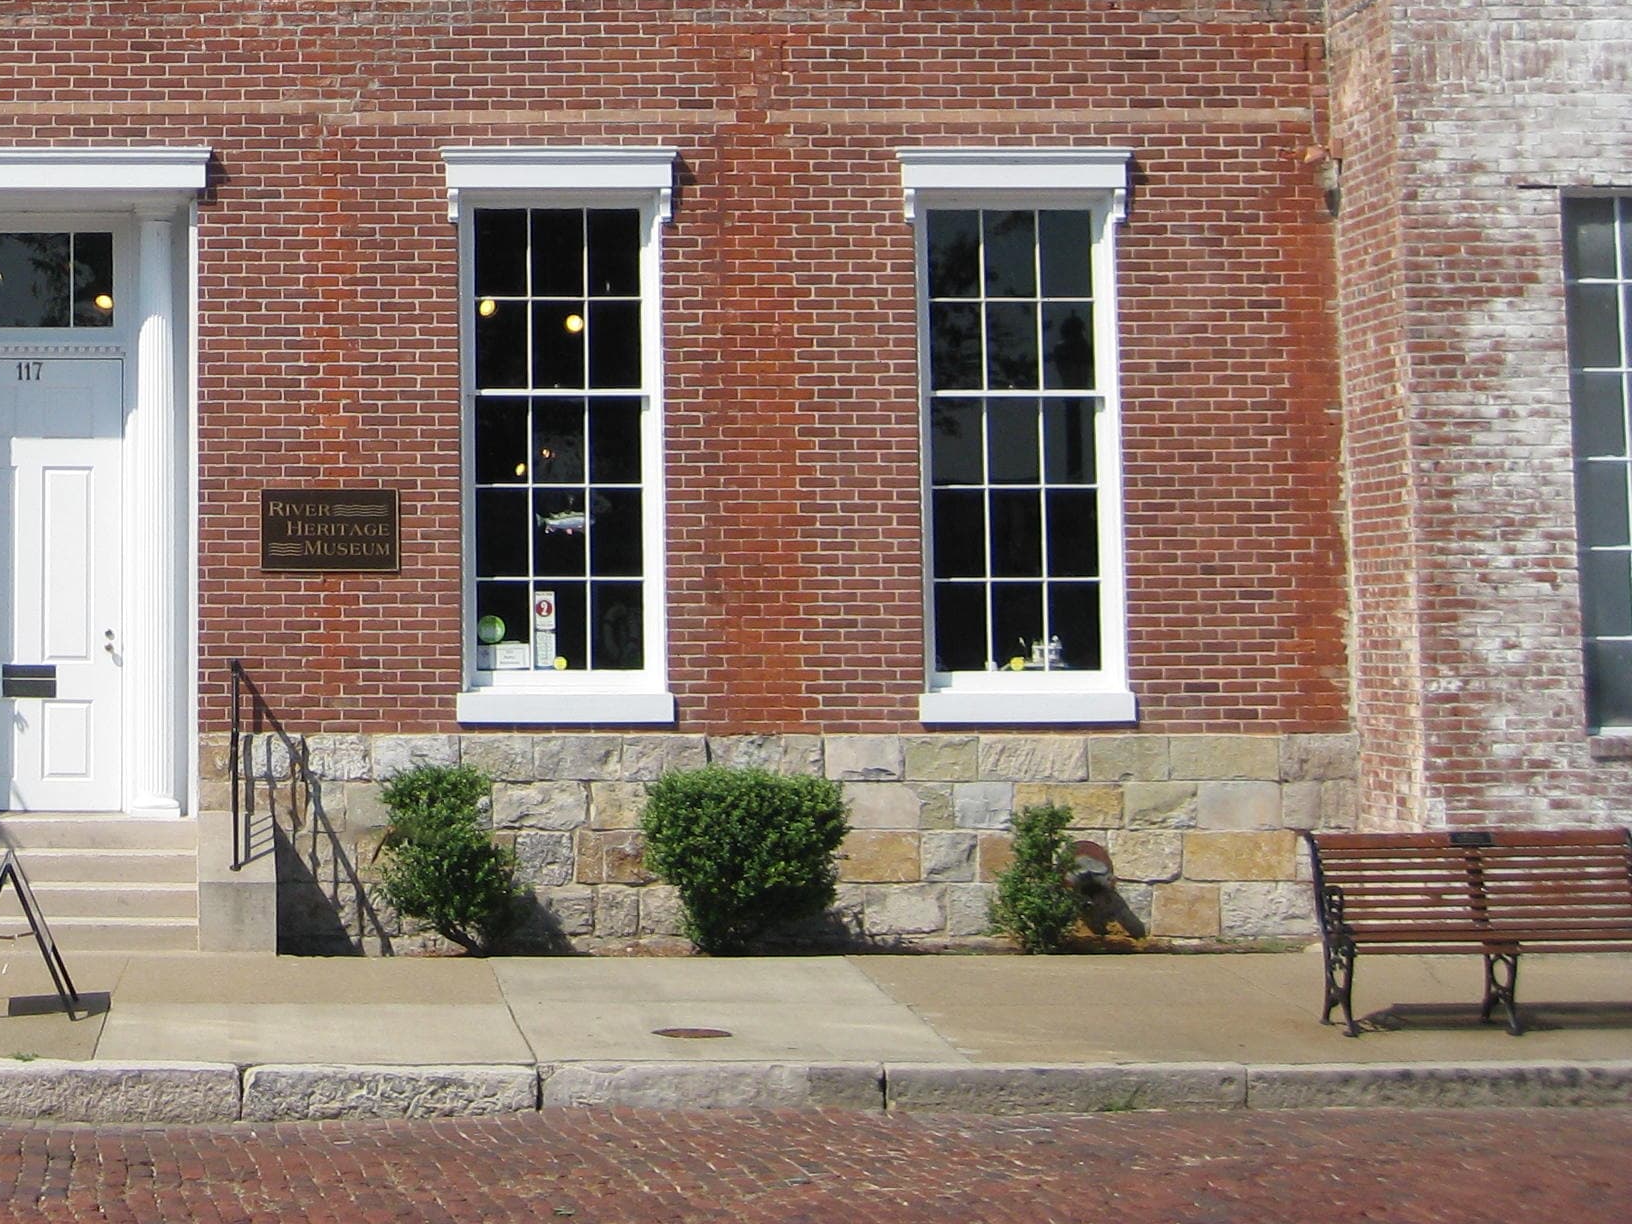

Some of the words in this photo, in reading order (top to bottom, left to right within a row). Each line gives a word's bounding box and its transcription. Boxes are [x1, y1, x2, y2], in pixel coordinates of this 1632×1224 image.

[16, 362, 44, 381] 117
[268, 501, 331, 517] RIVER
[286, 520, 390, 536] HERITAGE
[303, 540, 390, 556] MUSEUM
